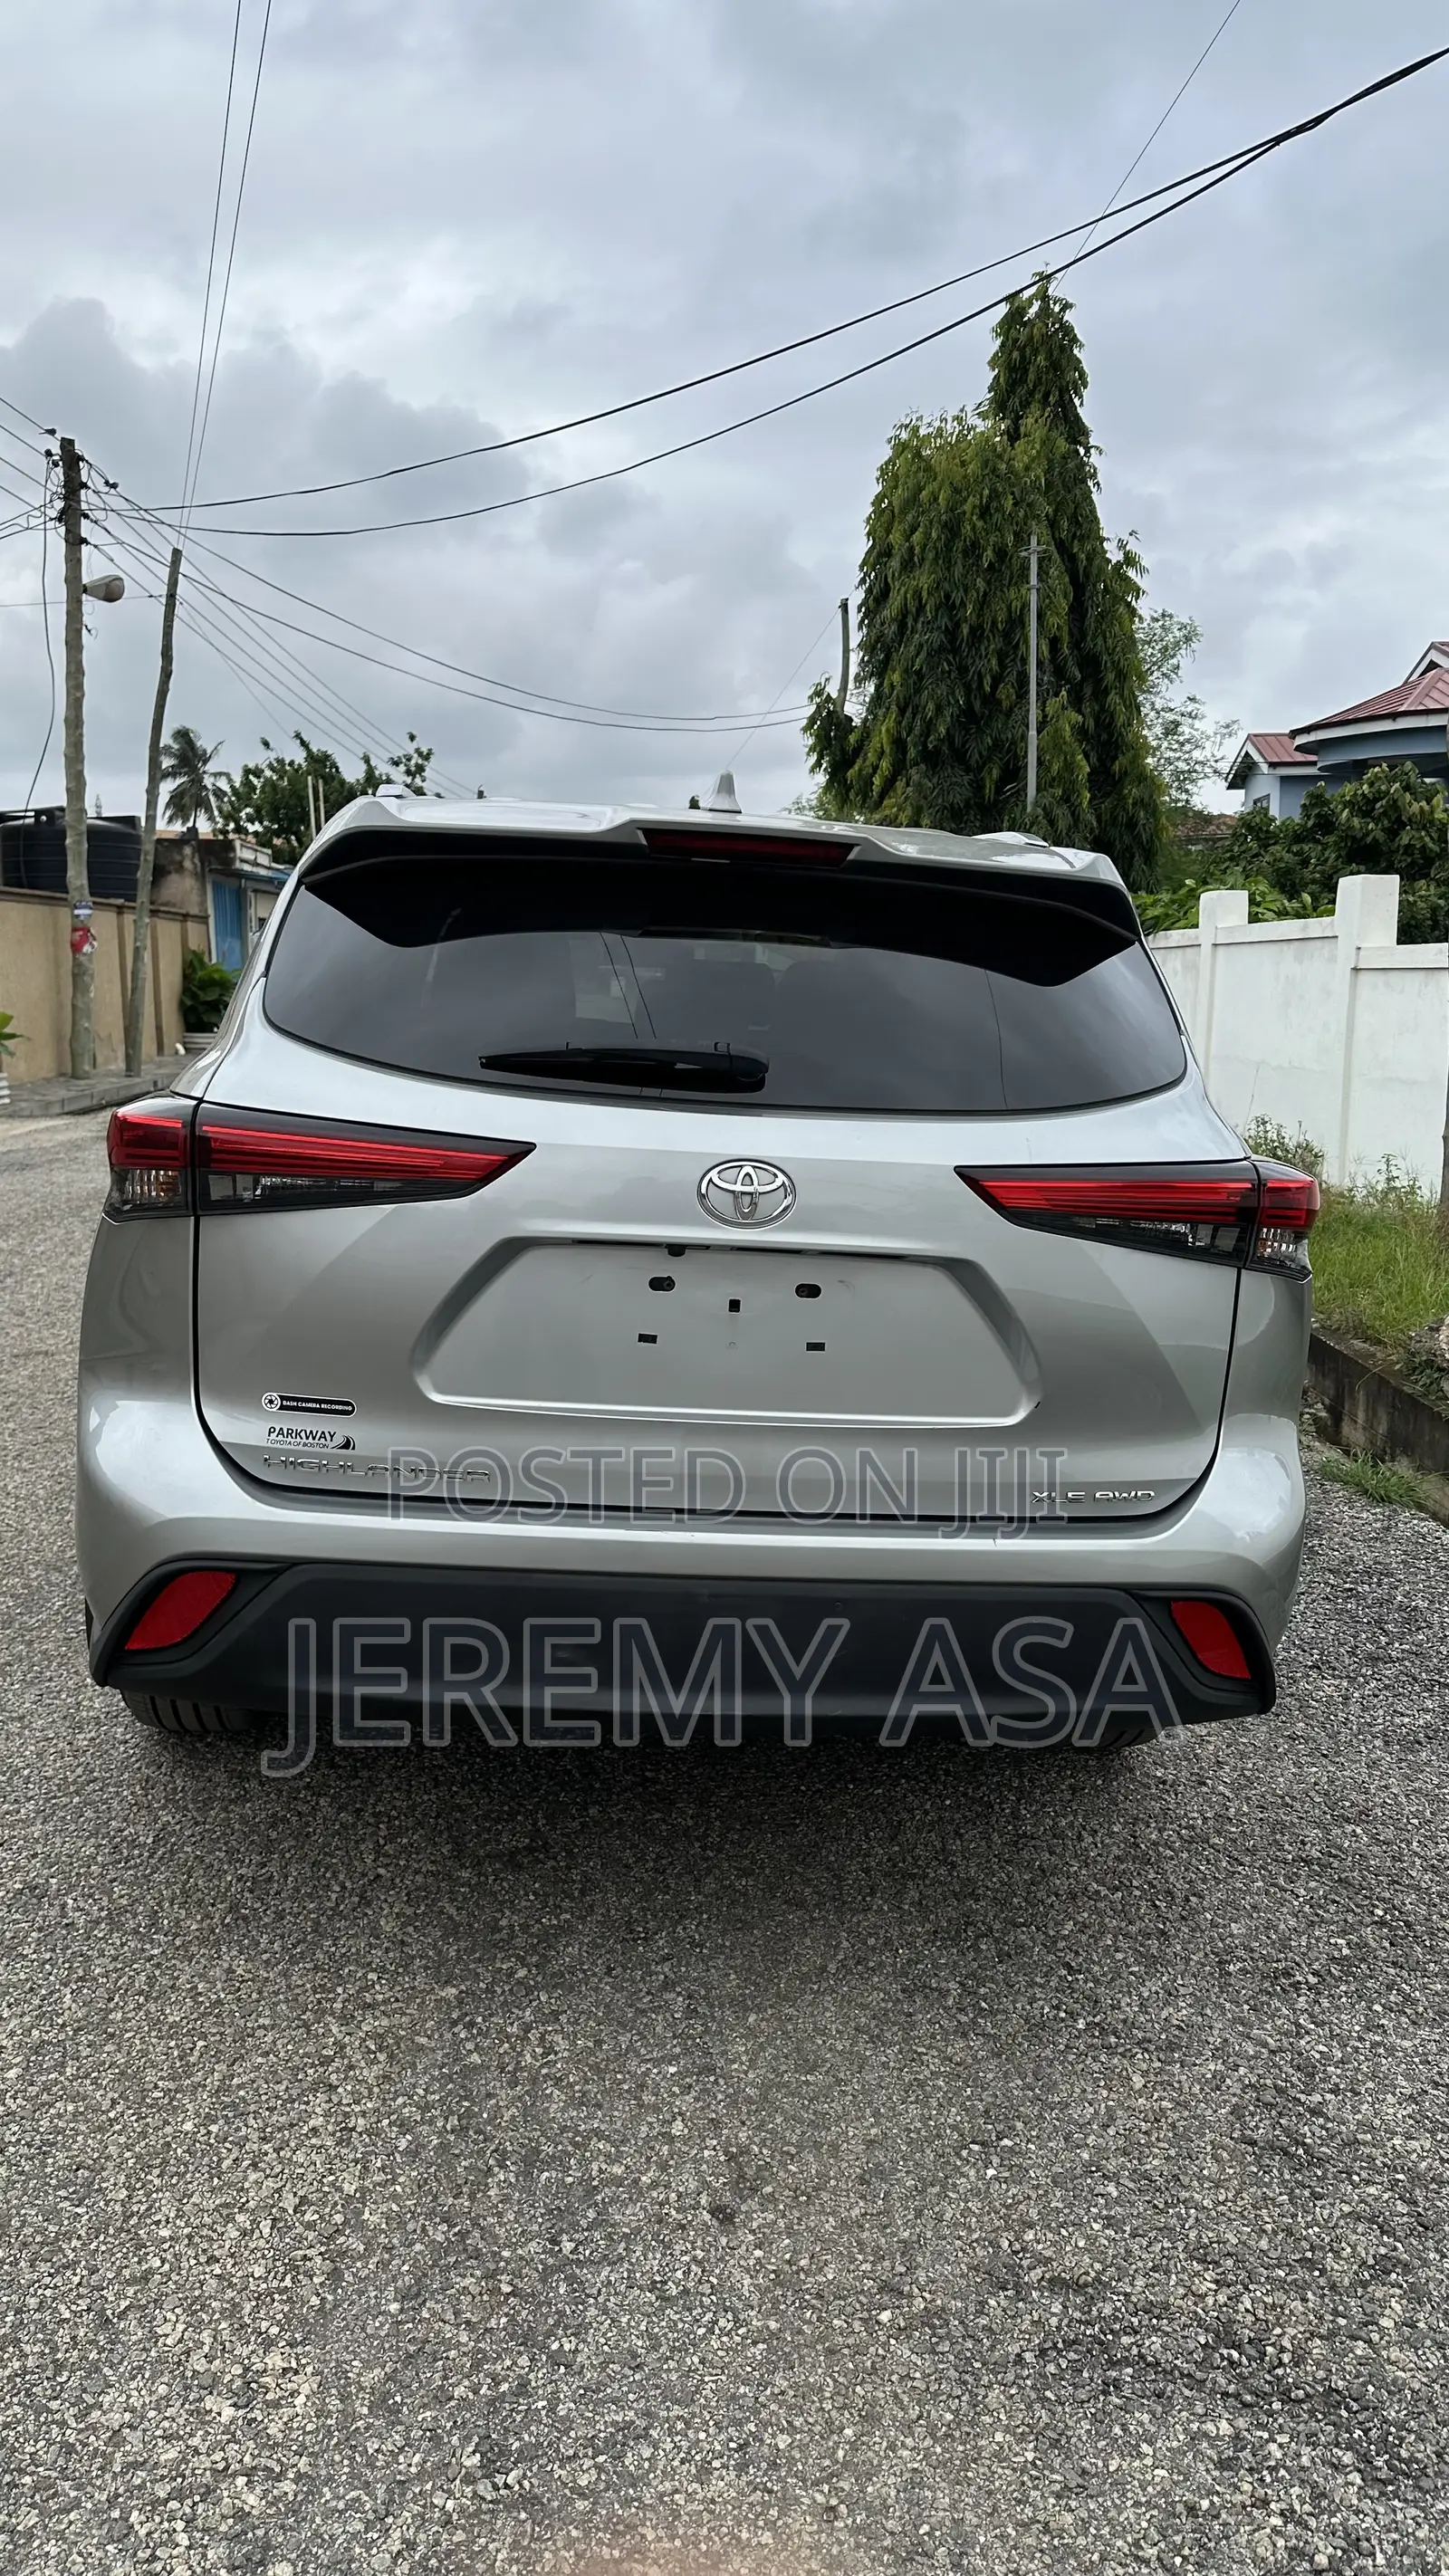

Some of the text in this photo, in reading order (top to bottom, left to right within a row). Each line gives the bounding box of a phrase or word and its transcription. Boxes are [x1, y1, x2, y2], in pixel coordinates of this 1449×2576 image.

[298, 1401, 321, 1409] CAMERA
[321, 1403, 352, 1411] RECORDING
[267, 1426, 336, 1442] PARKWAY
[266, 1438, 292, 1446] TOYOTA
[263, 1454, 491, 1483] HIGHLANDER
[1032, 1489, 1156, 1504] XLE AWD
